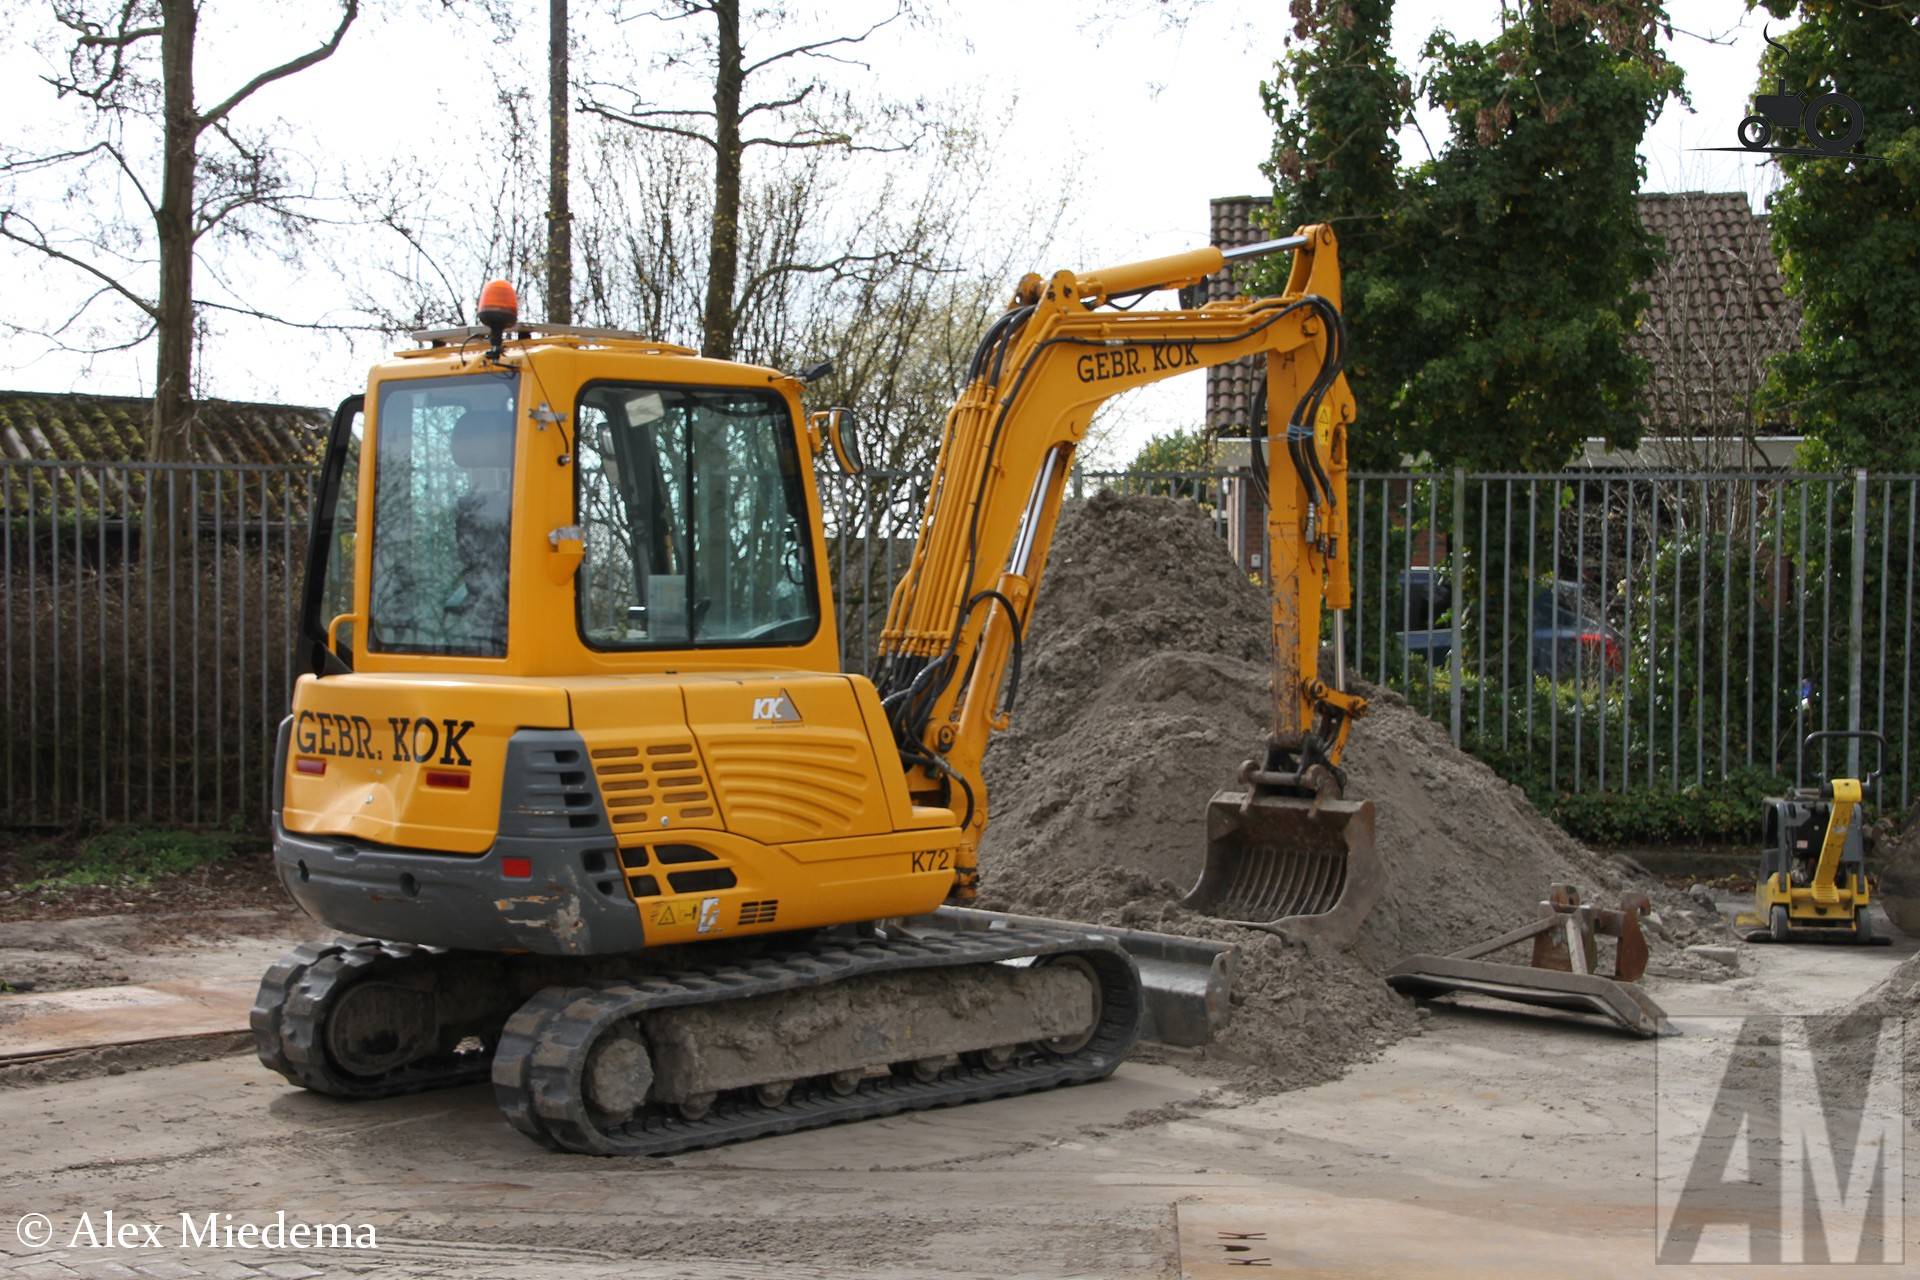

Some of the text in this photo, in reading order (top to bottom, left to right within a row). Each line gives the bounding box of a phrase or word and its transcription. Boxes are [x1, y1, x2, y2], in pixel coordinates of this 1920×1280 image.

[1076, 342, 1199, 383] GEBR. KOK
[296, 710, 475, 767] GEBR. KOK
[911, 848, 949, 873] K72
